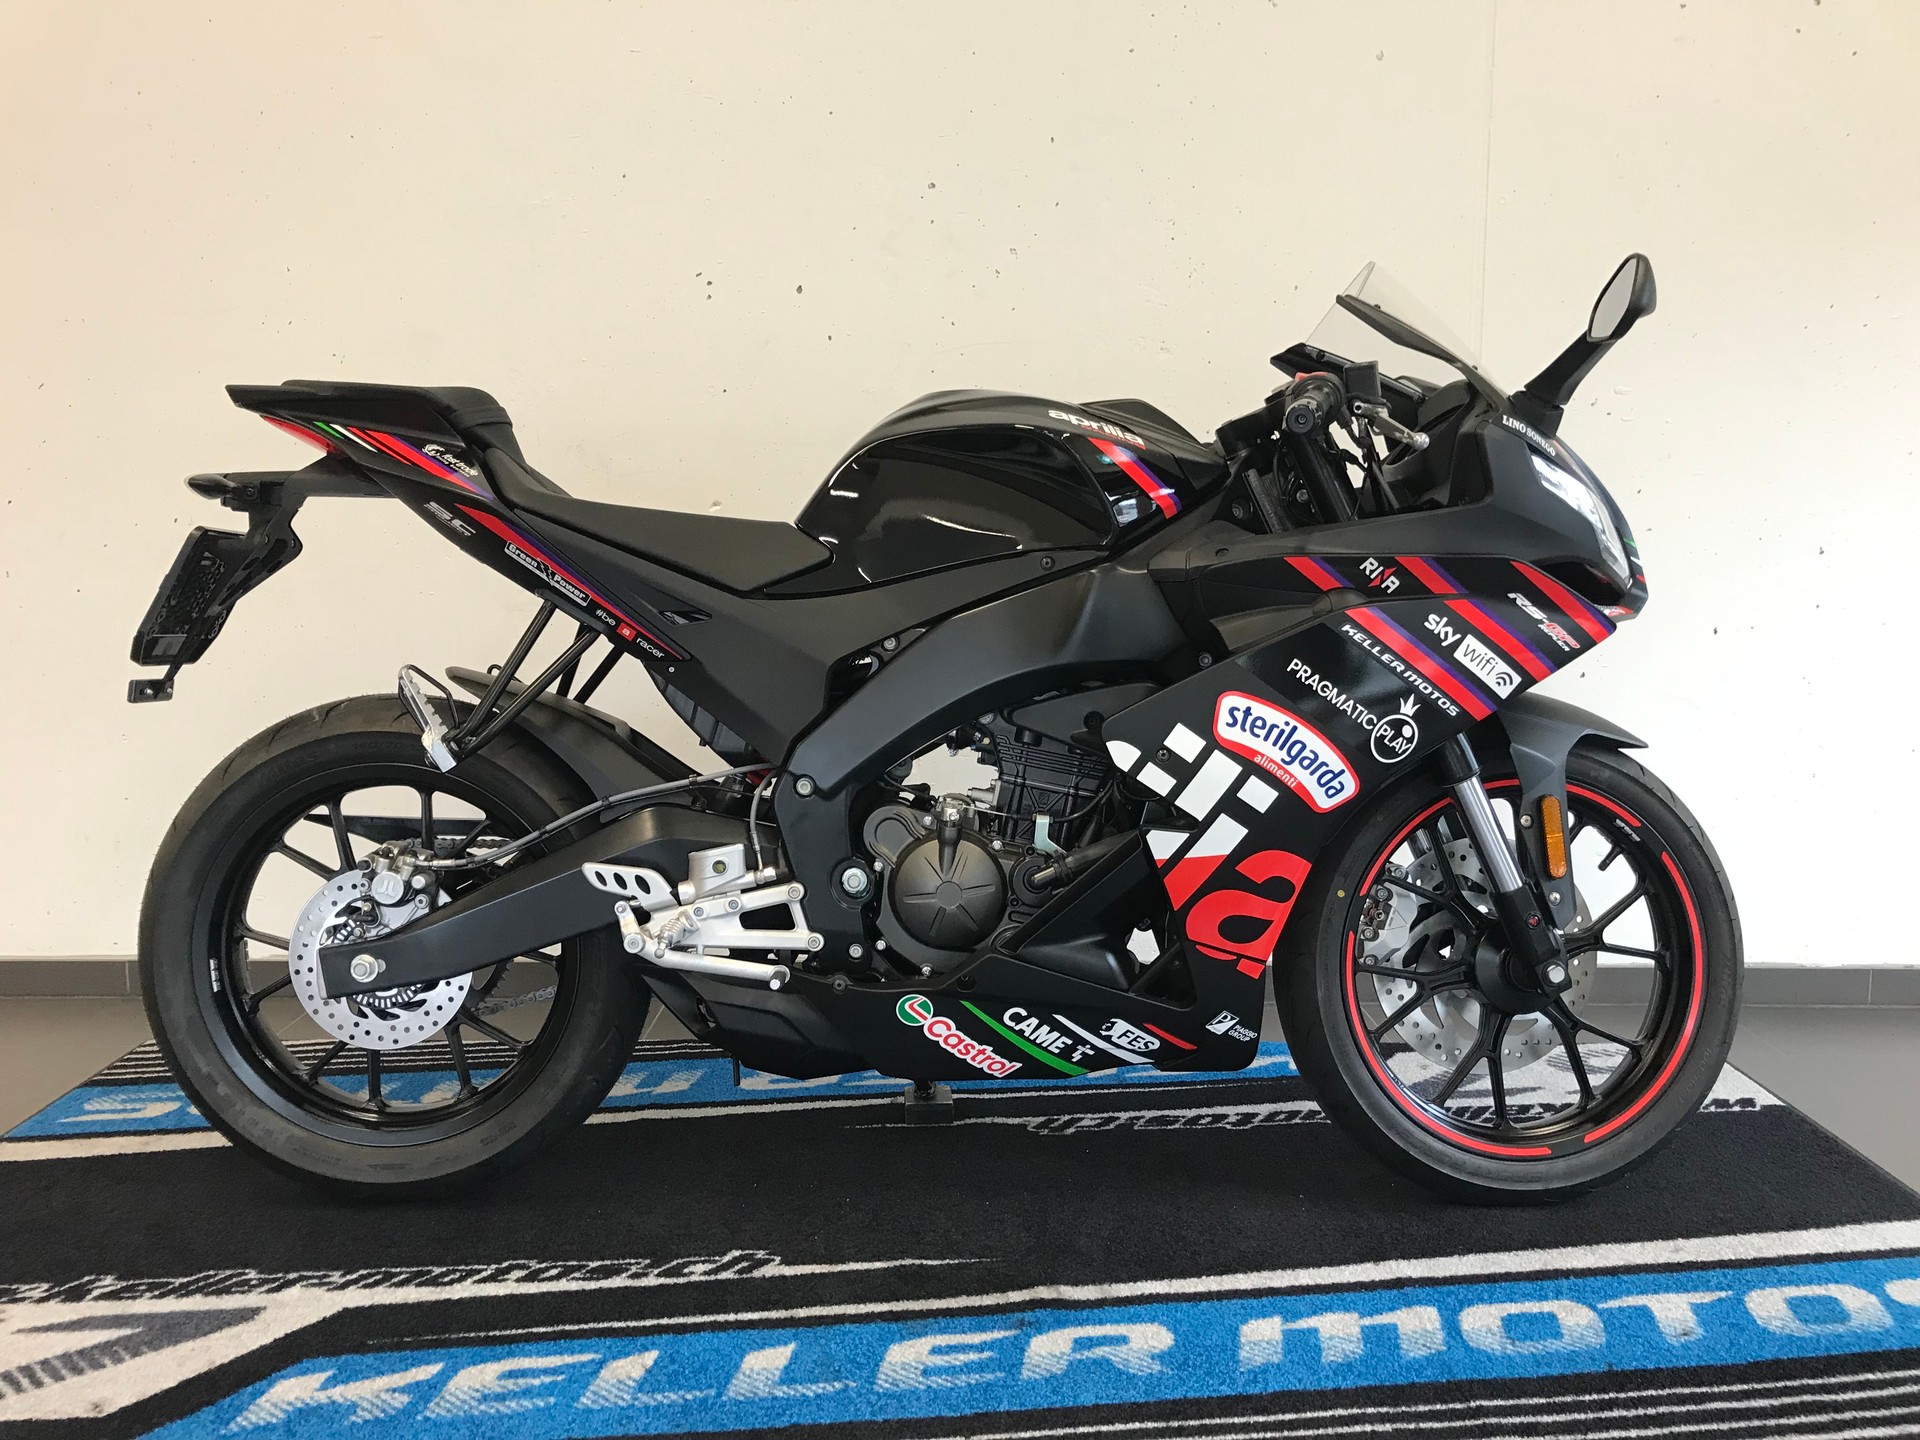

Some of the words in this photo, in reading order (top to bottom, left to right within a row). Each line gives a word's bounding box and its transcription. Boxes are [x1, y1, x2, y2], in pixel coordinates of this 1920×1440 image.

[1047, 409, 1145, 447] aprilia
[1502, 414, 1526, 434] LINO
[1526, 427, 1557, 457] SONEGO
[508, 543, 539, 568] Green
[553, 573, 587, 601] Power
[595, 608, 616, 627] #be
[636, 637, 665, 659] racer
[1423, 613, 1462, 647] sky
[1462, 644, 1499, 678] wifi
[1286, 657, 1378, 731] PRAGMATIC
[1340, 623, 1405, 676] KELLER
[1403, 667, 1460, 719] MOTOS
[1226, 704, 1345, 800] sterilgarda
[1376, 725, 1411, 756] PLAY
[1253, 753, 1299, 790] alimenti
[922, 1015, 1022, 1078] Castrol
[1002, 1006, 1072, 1054] CAME
[1116, 1029, 1155, 1050] FES
[1228, 1029, 1251, 1042] GROUP
[1232, 1024, 1258, 1039] PIAGGIO
[219, 1321, 1176, 1434] KELLER
[1239, 1281, 1920, 1372] MOTO
